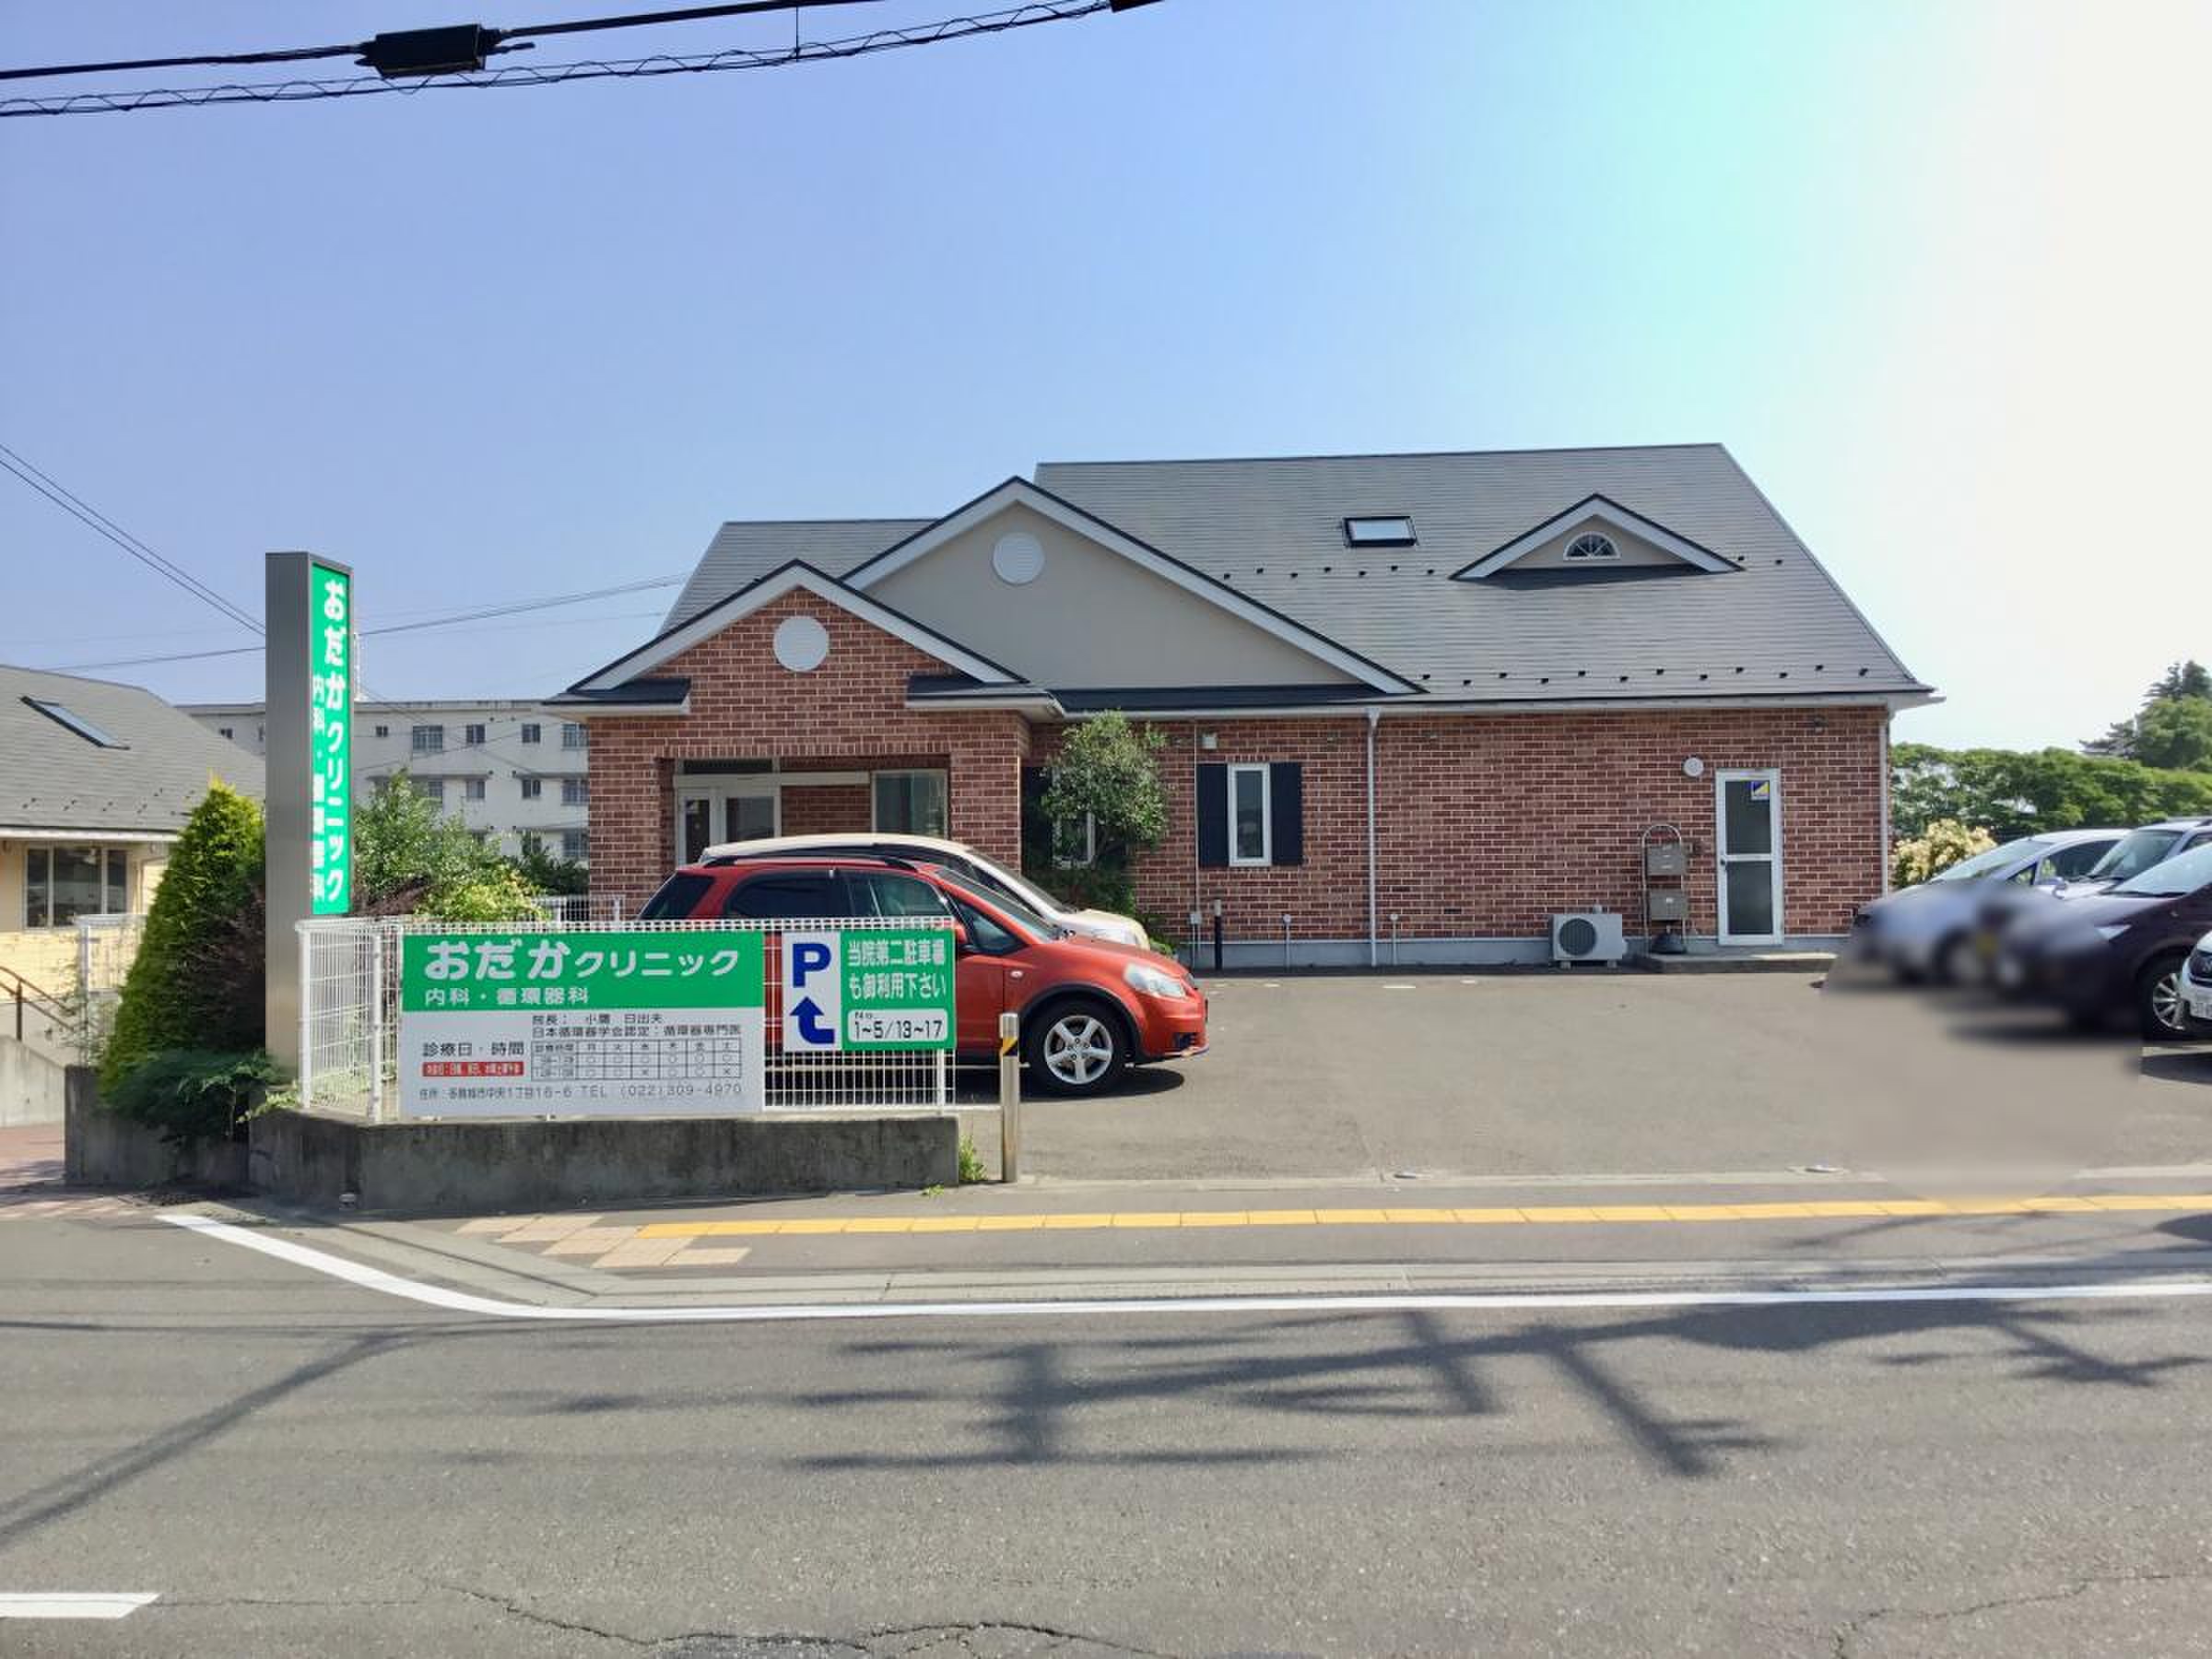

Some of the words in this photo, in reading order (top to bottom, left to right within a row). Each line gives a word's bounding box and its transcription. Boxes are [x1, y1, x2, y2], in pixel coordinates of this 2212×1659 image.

[324, 580, 347, 902] おだかクリニック
[793, 942, 831, 988] P
[425, 987, 589, 1006] 内科・循環器科
[850, 973, 947, 999] も御利用下さい
[582, 1084, 606, 1098] TEL
